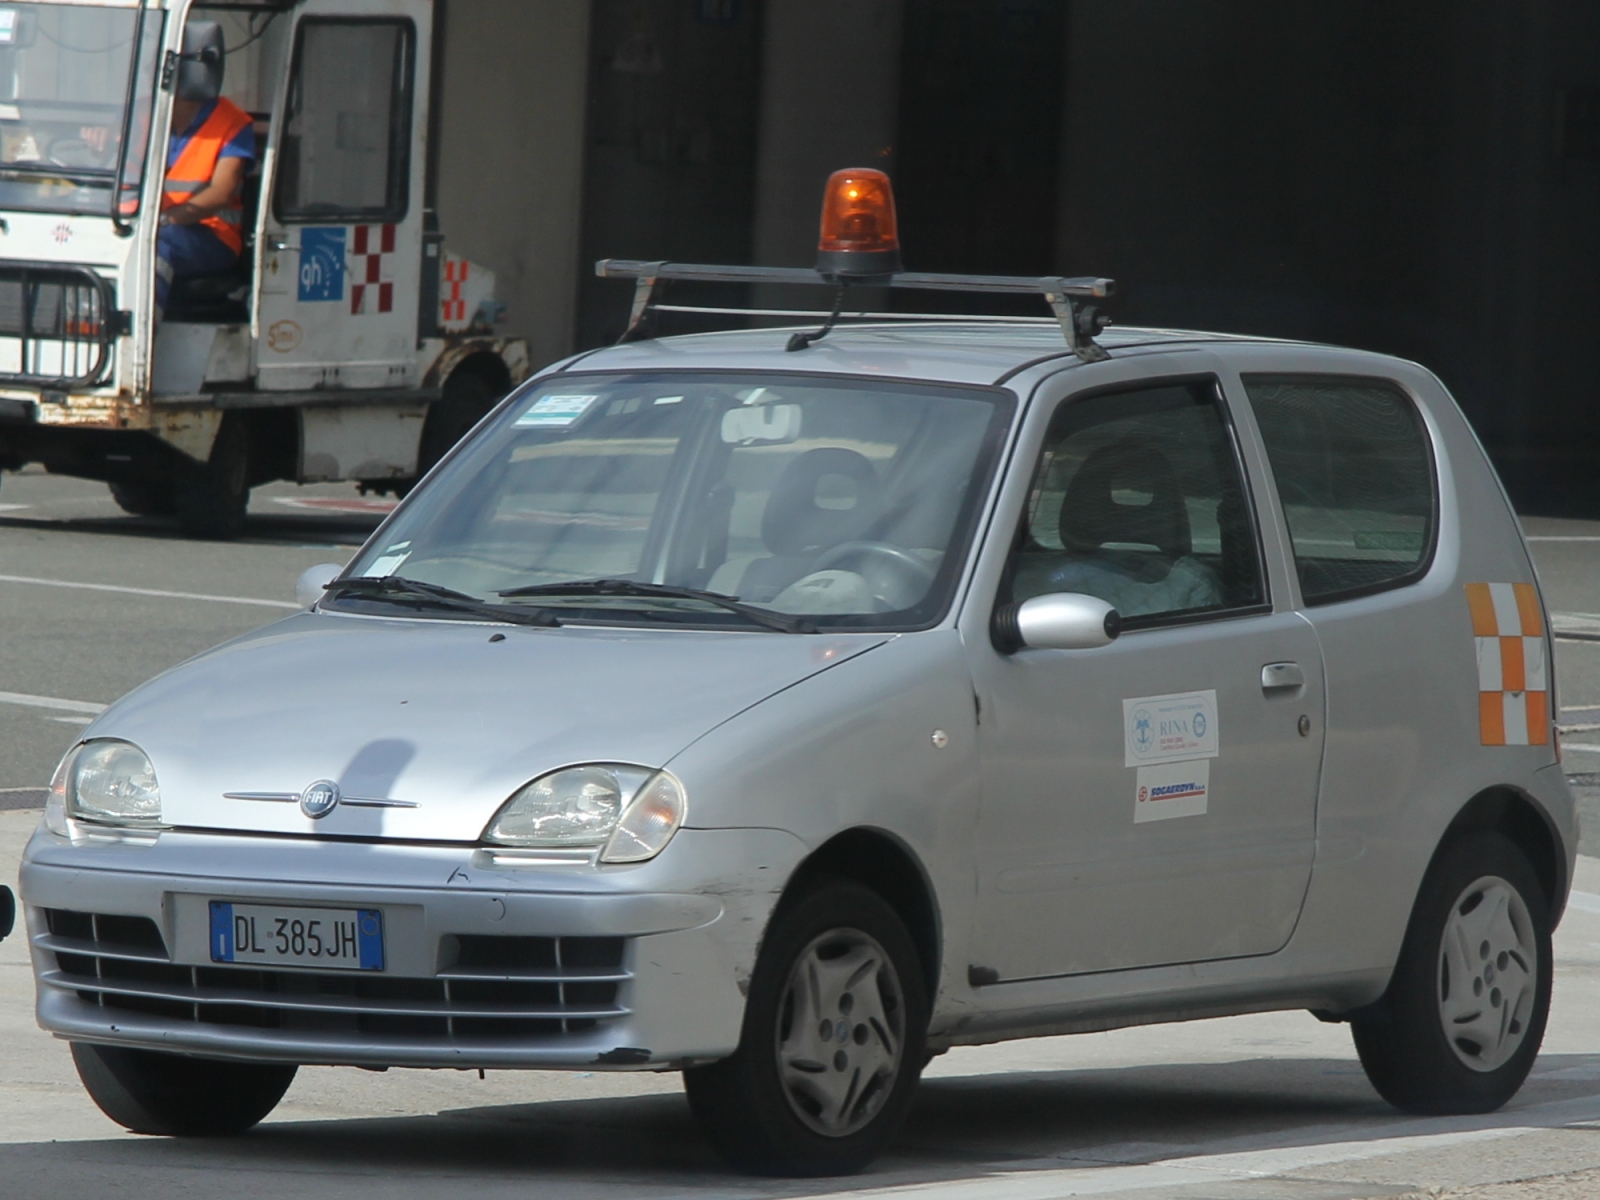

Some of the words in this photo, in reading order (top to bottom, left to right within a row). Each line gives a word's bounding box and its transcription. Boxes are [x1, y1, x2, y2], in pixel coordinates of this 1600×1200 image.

[301, 256, 322, 293] gh
[1160, 720, 1189, 736] RINA
[305, 790, 332, 805] FIAT
[235, 915, 265, 953] DL
[274, 917, 357, 958] 385JH
